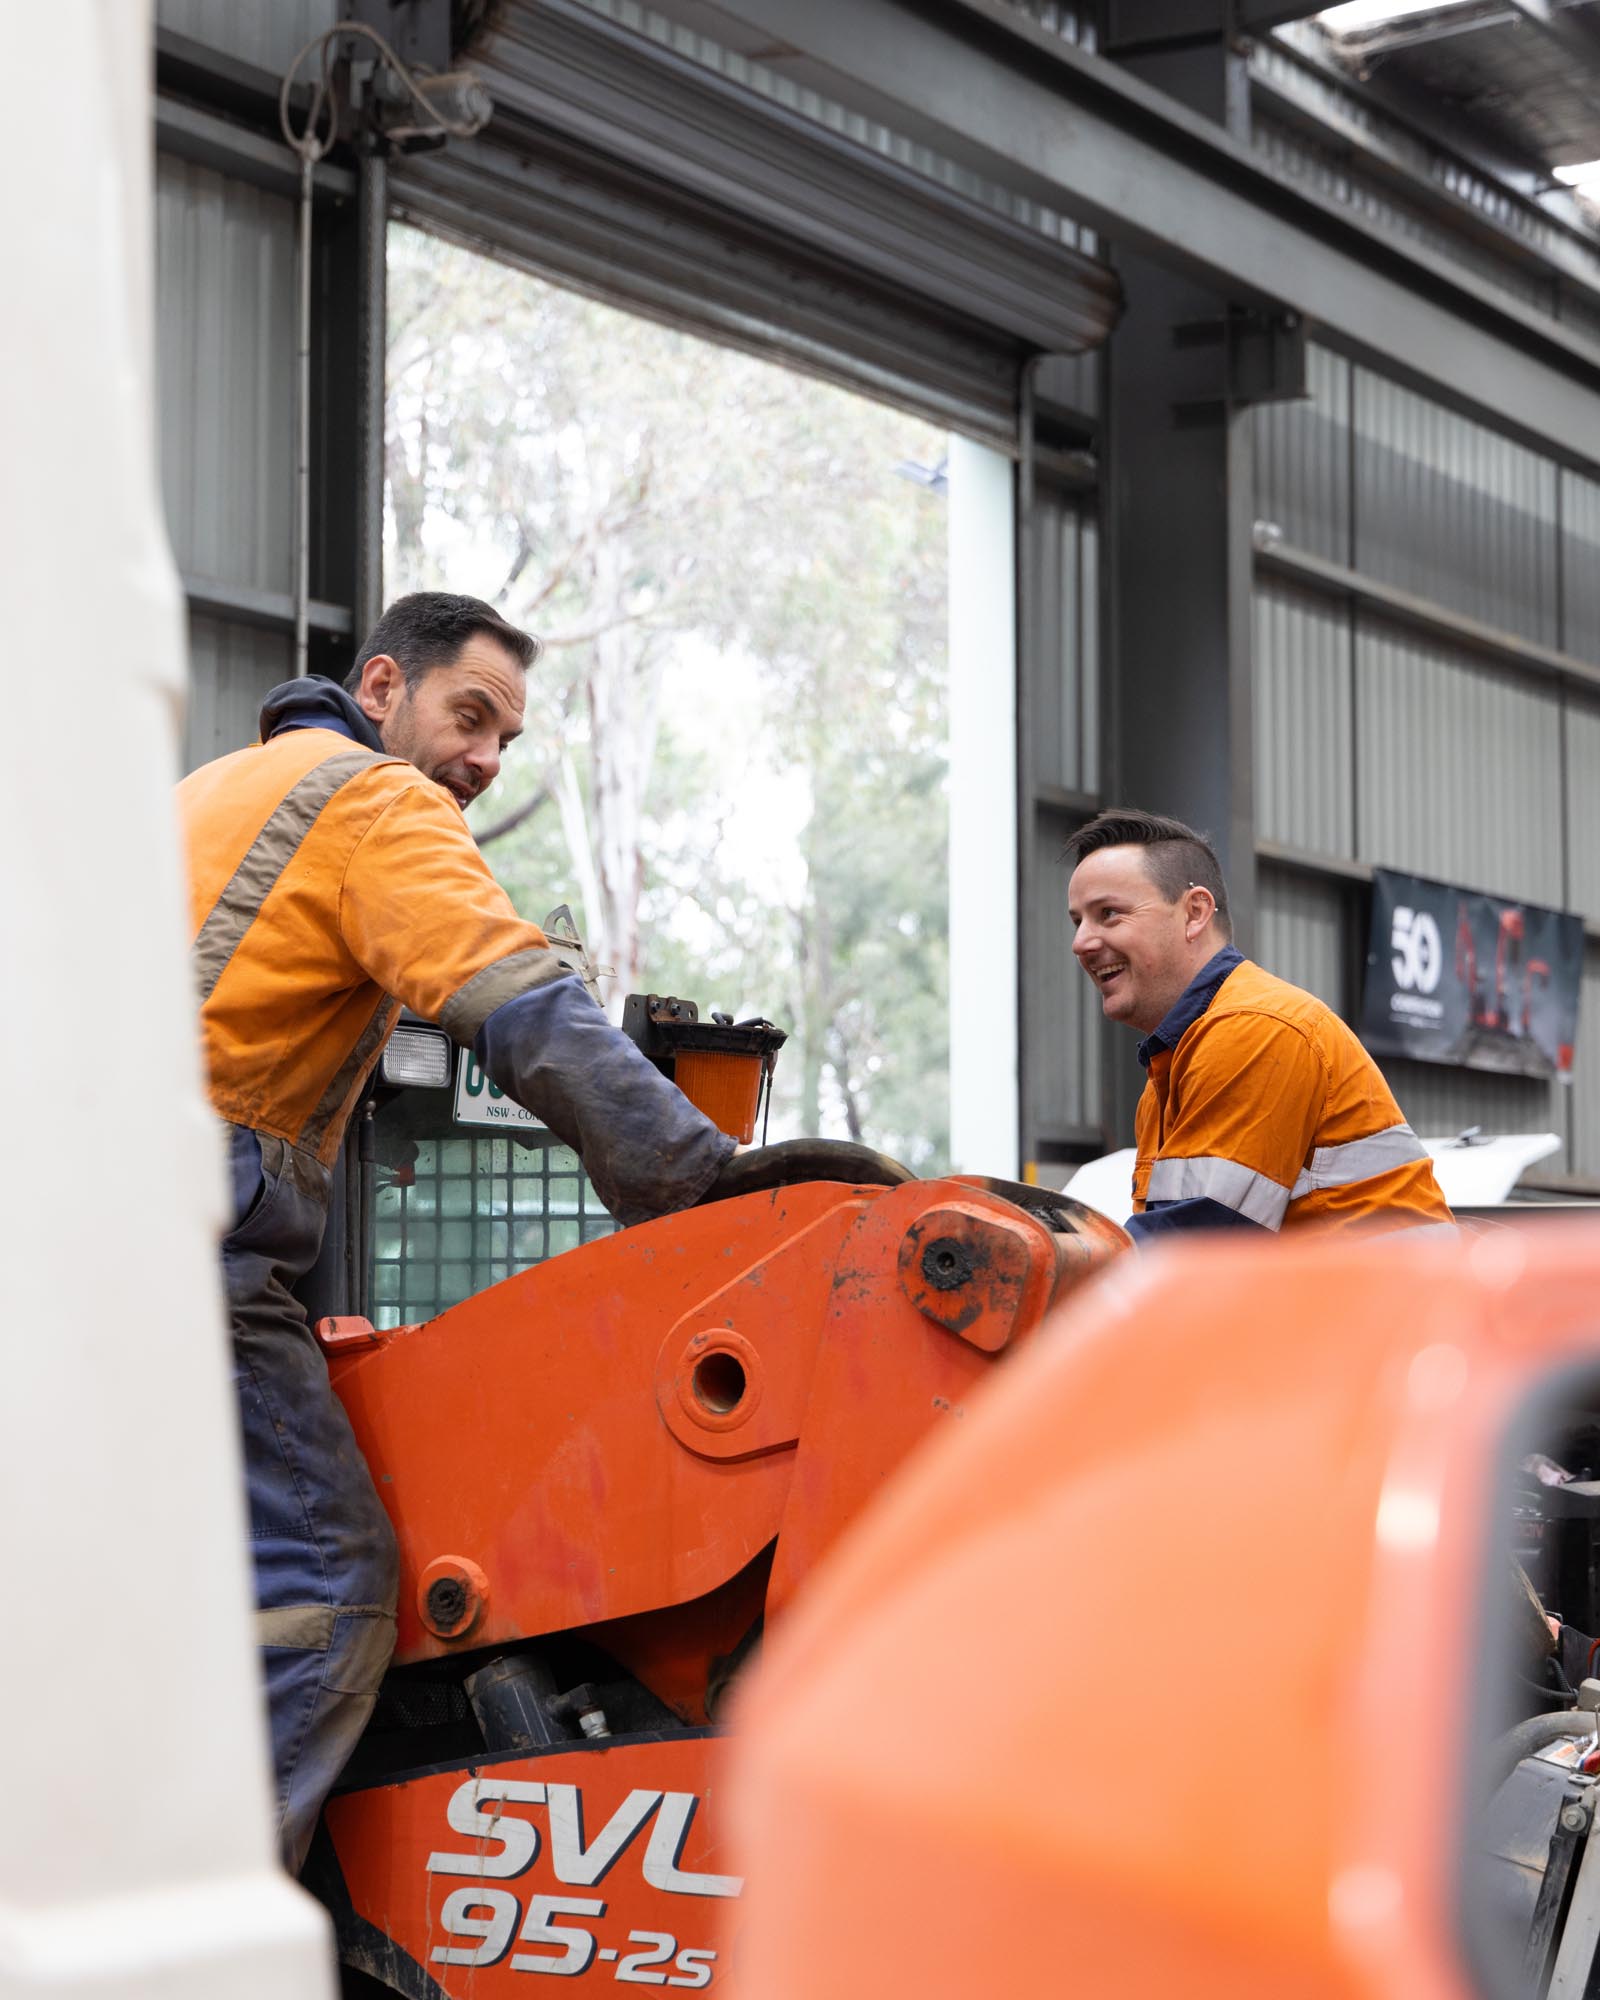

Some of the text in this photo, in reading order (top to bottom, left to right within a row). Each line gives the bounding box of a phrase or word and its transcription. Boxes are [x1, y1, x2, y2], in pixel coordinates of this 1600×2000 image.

[1391, 905, 1442, 994] 50
[486, 1106, 510, 1118] NSW
[426, 1778, 745, 1897] SVL
